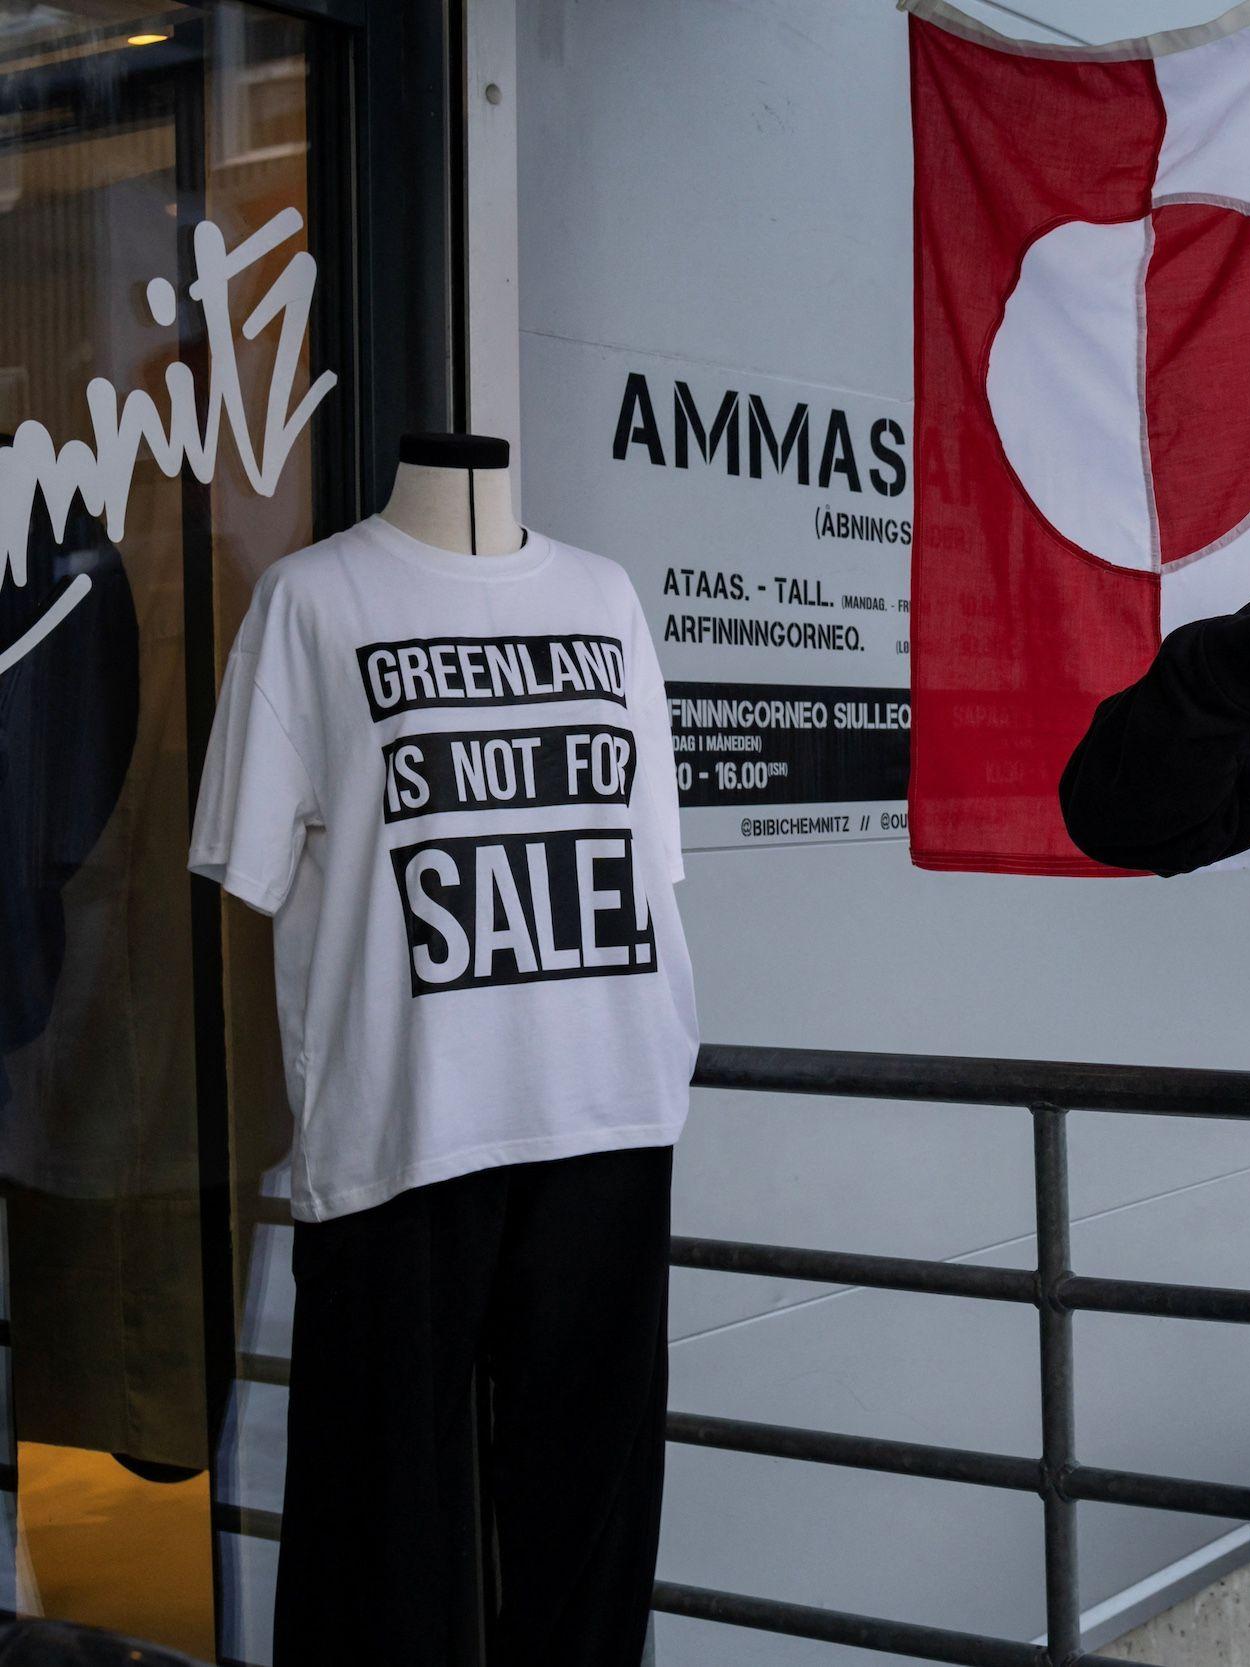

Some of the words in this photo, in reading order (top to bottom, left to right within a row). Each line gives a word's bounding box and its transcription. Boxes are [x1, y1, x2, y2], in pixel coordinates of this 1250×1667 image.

[663, 567, 750, 601] ATAAS.
[774, 577, 834, 607] TALL.
[841, 594, 887, 612] (MANDAG.
[664, 614, 865, 651] ARFININNGORNEQ.
[367, 640, 625, 709] GREENLAND
[834, 702, 912, 730] SIULLEQ
[698, 735, 703, 751] I
[706, 732, 762, 753] MÅNEDEN)
[387, 745, 430, 813] IS
[451, 736, 541, 802] NOT
[565, 733, 630, 796] FOR
[741, 816, 849, 837] @BIBICHEMNITZ
[405, 838, 651, 984] SALE!
